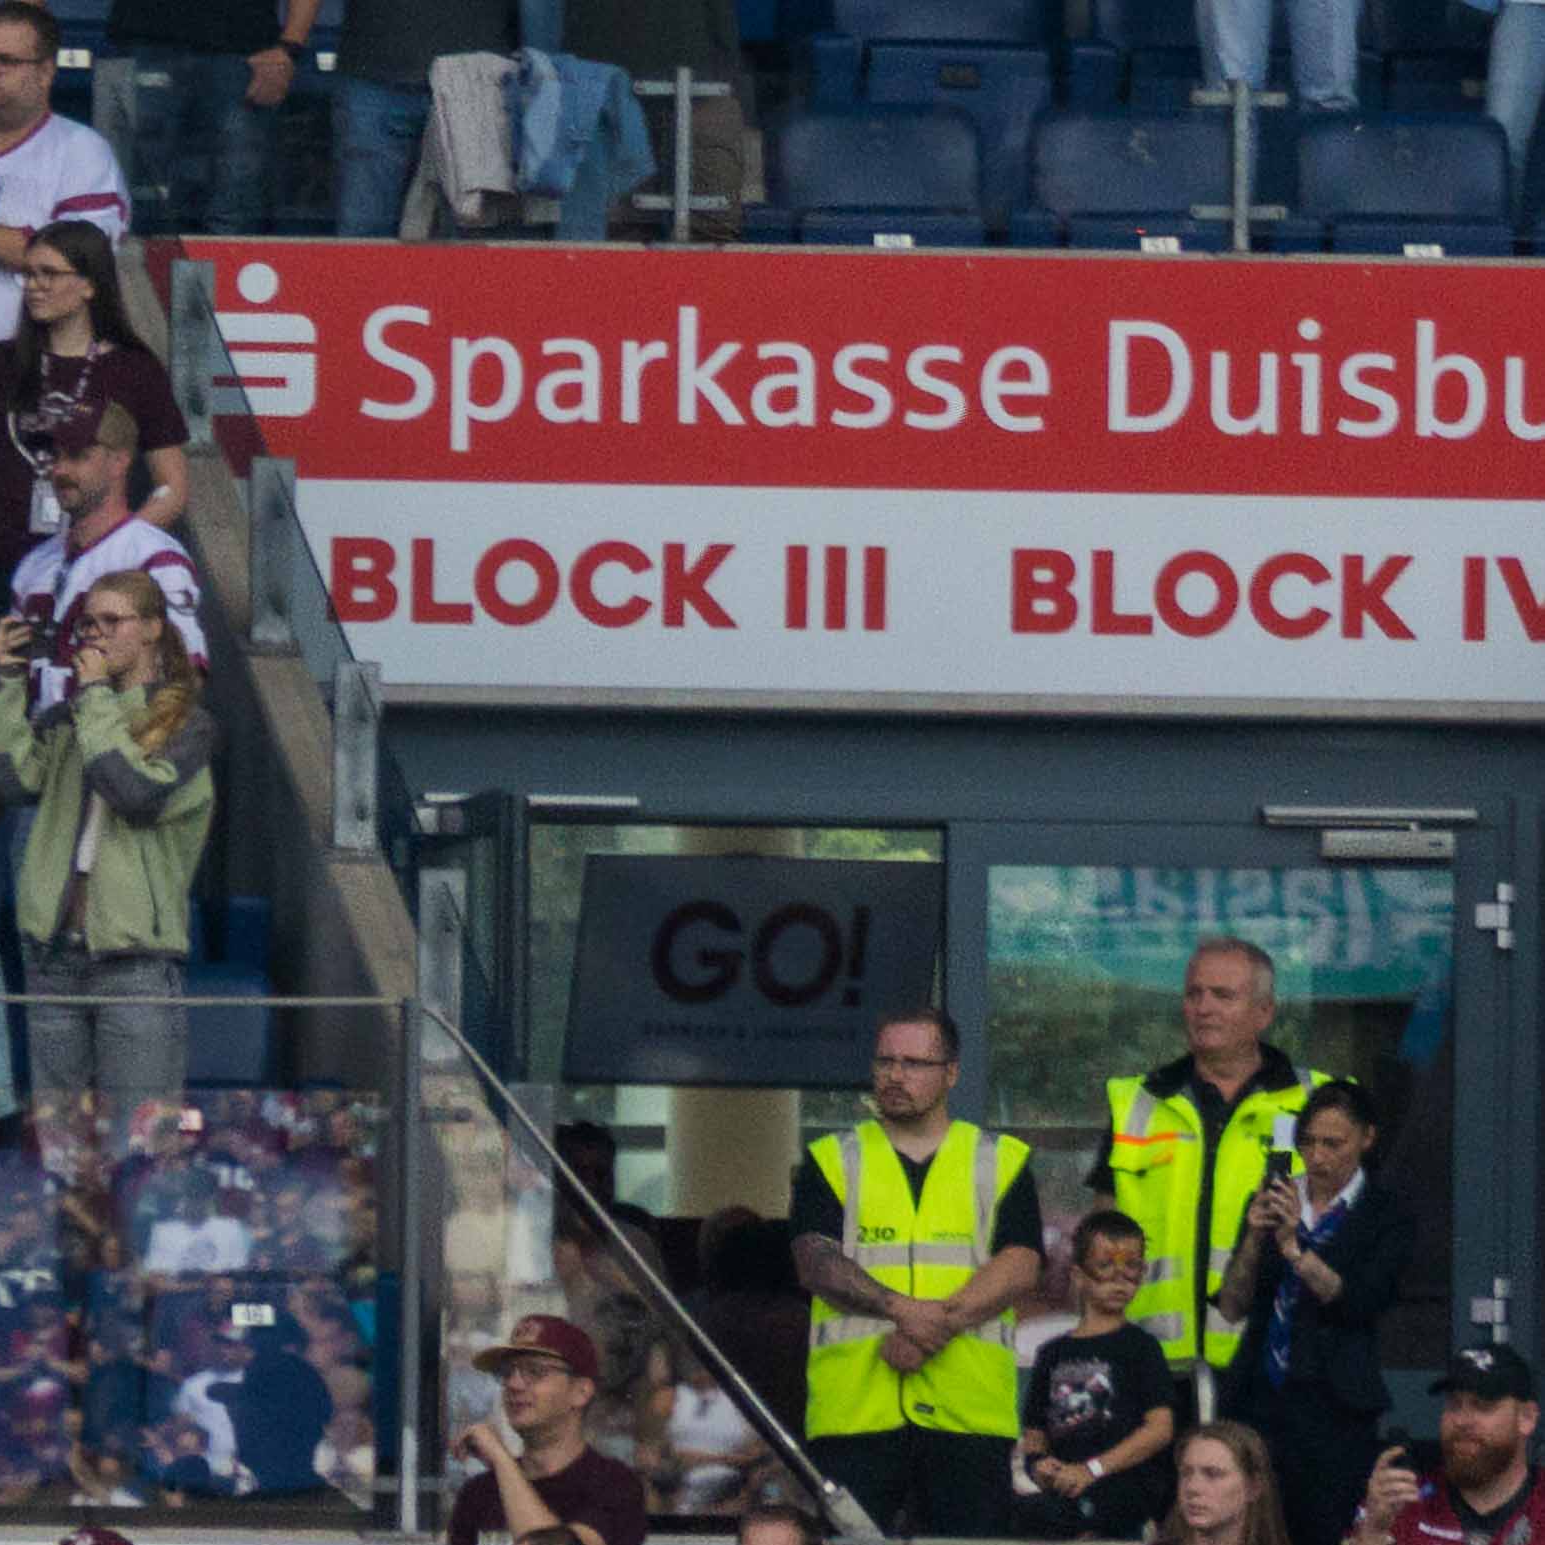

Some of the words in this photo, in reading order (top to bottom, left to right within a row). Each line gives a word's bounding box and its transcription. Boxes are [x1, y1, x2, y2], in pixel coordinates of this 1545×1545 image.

[359, 305, 1053, 452] Sparkasse
[330, 537, 736, 629] BLOCK
[784, 544, 887, 632] III
[1011, 547, 1416, 641] BLOCK
[653, 901, 870, 1007] GO!
